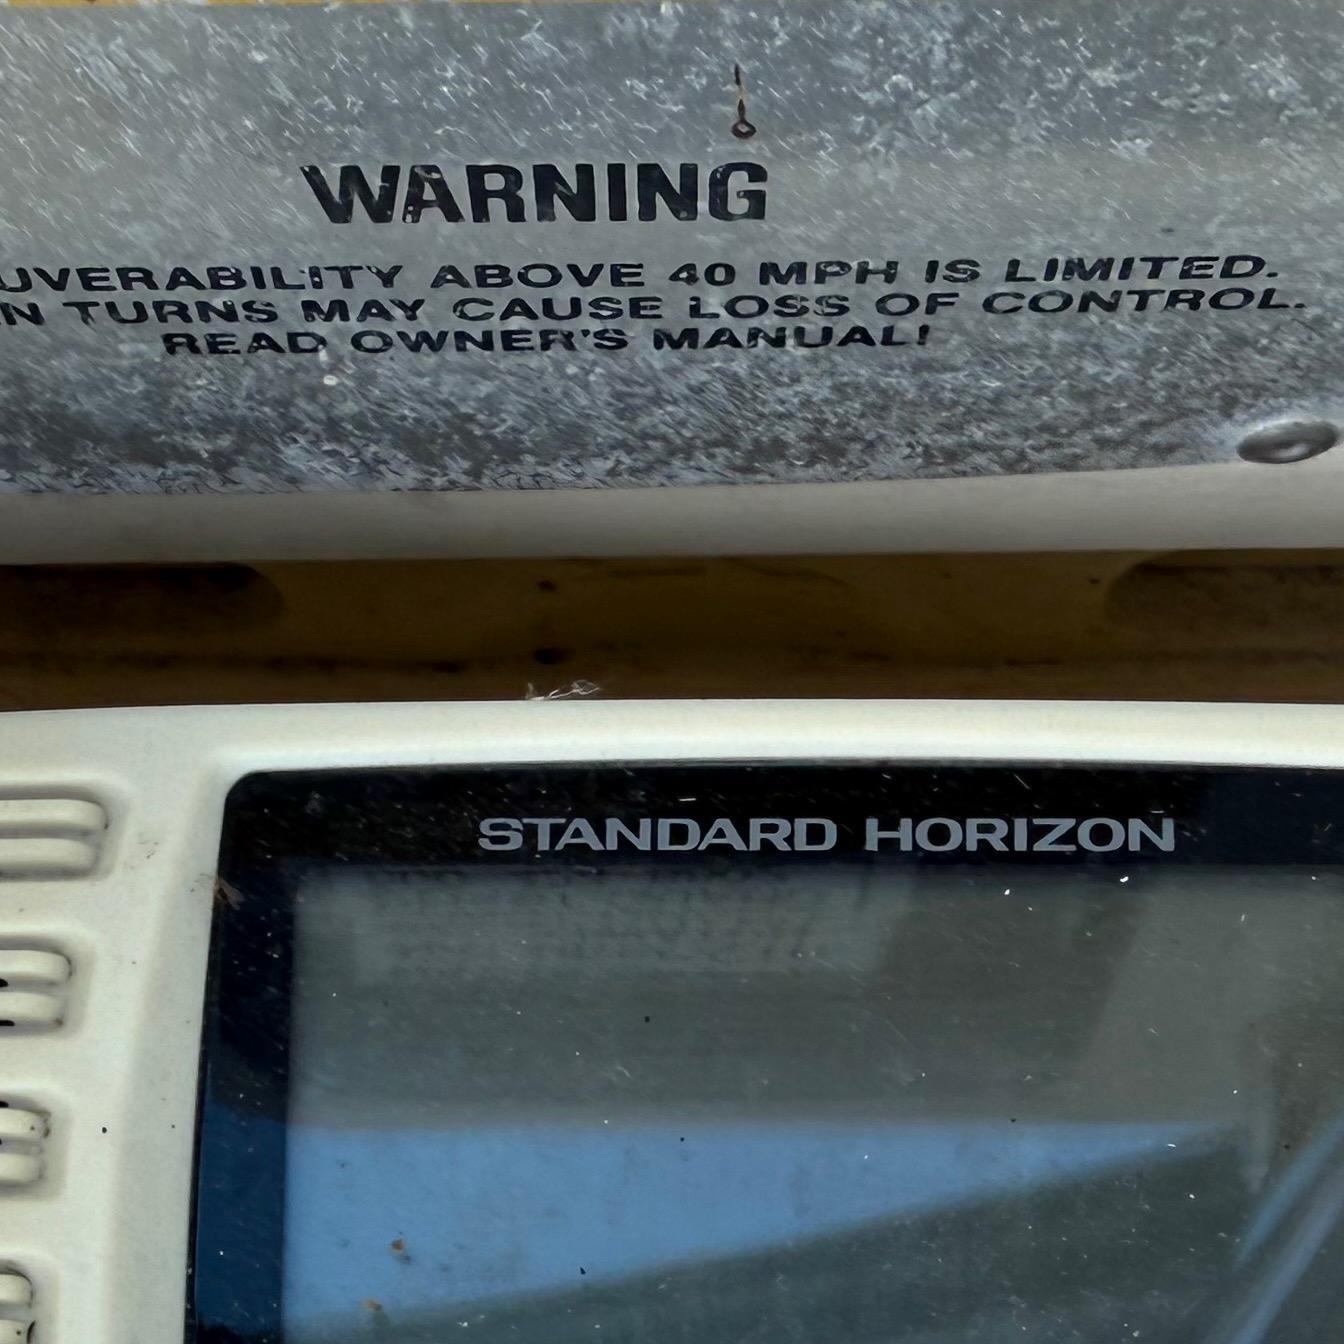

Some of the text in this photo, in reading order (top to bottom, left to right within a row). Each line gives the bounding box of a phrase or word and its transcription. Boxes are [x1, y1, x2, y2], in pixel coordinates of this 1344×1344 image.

[301, 162, 769, 225] WARNING
[432, 261, 644, 290] ABOVE
[668, 262, 736, 287] 40
[759, 260, 898, 287] MPH
[925, 258, 981, 285] IS
[1005, 254, 1280, 284] LIMITED.
[63, 299, 277, 326] TURNS
[301, 298, 426, 324] MAY
[454, 295, 663, 323] CAUSE
[689, 293, 851, 320] LOSS
[875, 292, 960, 317] OF
[981, 286, 1308, 317] CONTROL.
[162, 324, 932, 356] READ OWNER'S MANUAL!
[478, 817, 1177, 854] STANDARD HORIZON
